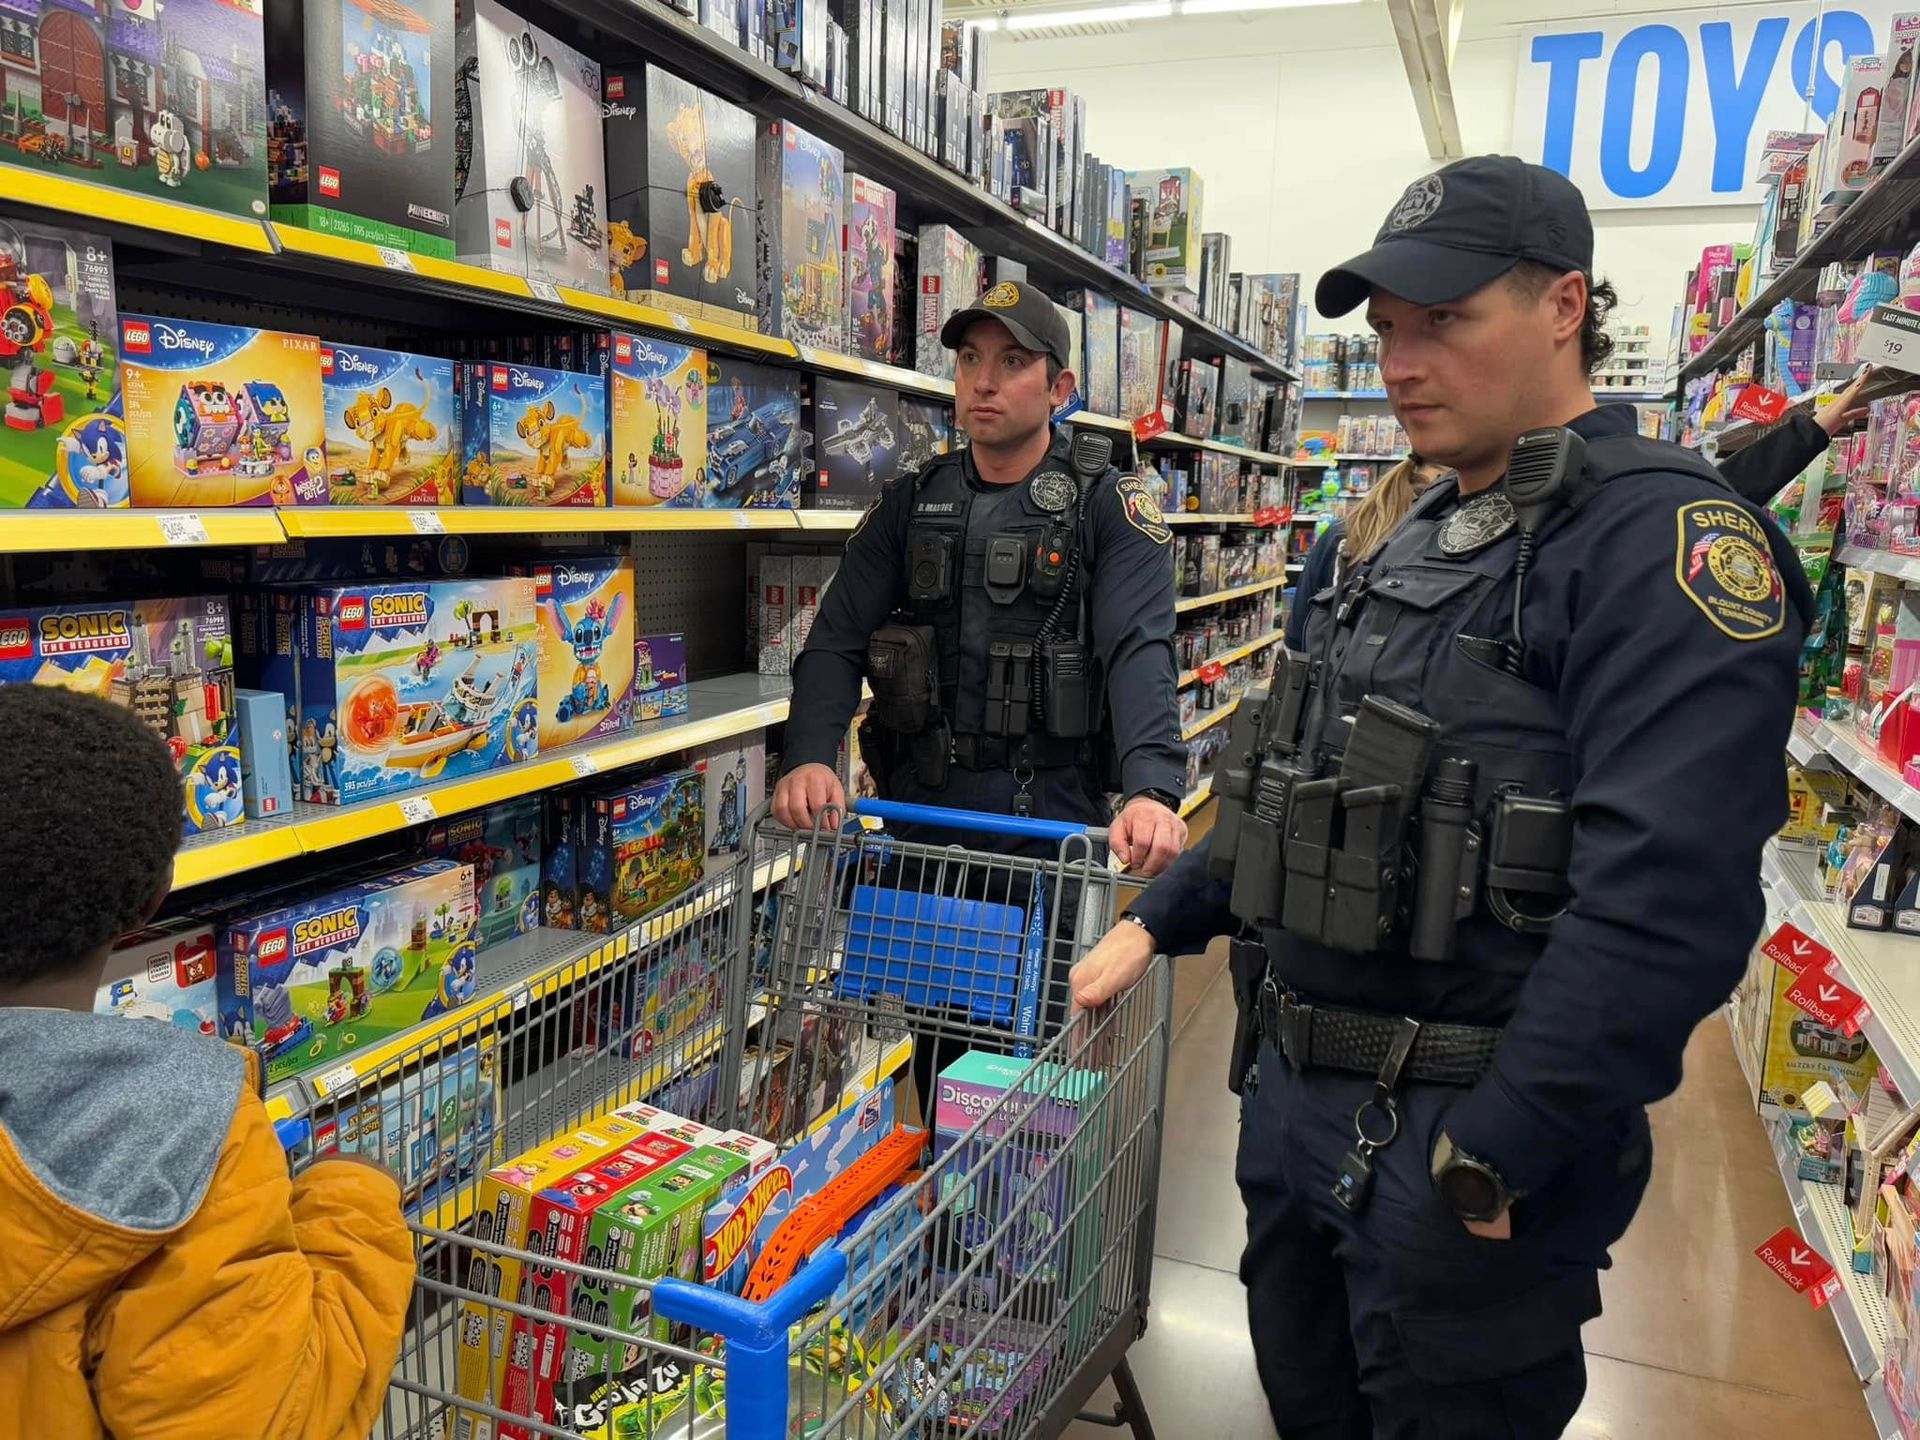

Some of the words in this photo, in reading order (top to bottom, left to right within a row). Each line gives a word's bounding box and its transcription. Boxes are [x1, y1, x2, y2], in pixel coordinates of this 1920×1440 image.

[601, 102, 637, 120] Disney
[1531, 10, 1874, 199] TOYS
[320, 174, 338, 189] LEGO
[87, 246, 107, 261] 8+
[84, 264, 108, 275] 76993
[924, 297, 938, 333] MARVEL
[1882, 311, 1897, 322] LAST
[1896, 315, 1919, 328] MINUTE
[126, 331, 149, 343] LEGO
[154, 324, 215, 358] Disney
[283, 338, 317, 352] PIXAR
[1884, 339, 1902, 355] $19
[320, 355, 333, 368] EGO
[336, 350, 379, 376] Disney
[616, 344, 631, 357] LEGO
[633, 338, 668, 371] Disney
[126, 369, 141, 379] 9+
[493, 373, 508, 384] LEGO
[509, 368, 544, 394] Disney
[1692, 510, 1767, 545] SHERIF
[536, 574, 551, 585] LEGO
[554, 565, 595, 589] Disney
[206, 601, 224, 615] 8+
[340, 606, 363, 620] LEGO
[372, 594, 425, 616] SONIC
[1708, 595, 1743, 610] BLOUNT
[41, 611, 126, 641] SONIC
[43, 643, 65, 653] THE
[69, 636, 129, 650] HEDGEHOG
[628, 795, 656, 811] Disney
[450, 819, 482, 838] SONIC
[461, 870, 473, 881] 6+
[260, 936, 286, 956] LEGO
[295, 908, 356, 943] SONIC
[1789, 989, 1837, 1025] Rollback
[1020, 1006, 1032, 1050] Walmrt
[713, 1213, 746, 1277] HOT
[742, 1169, 789, 1234] WHEELS
[1760, 1247, 1804, 1288] Rollback
[652, 1360, 680, 1393] ZU
